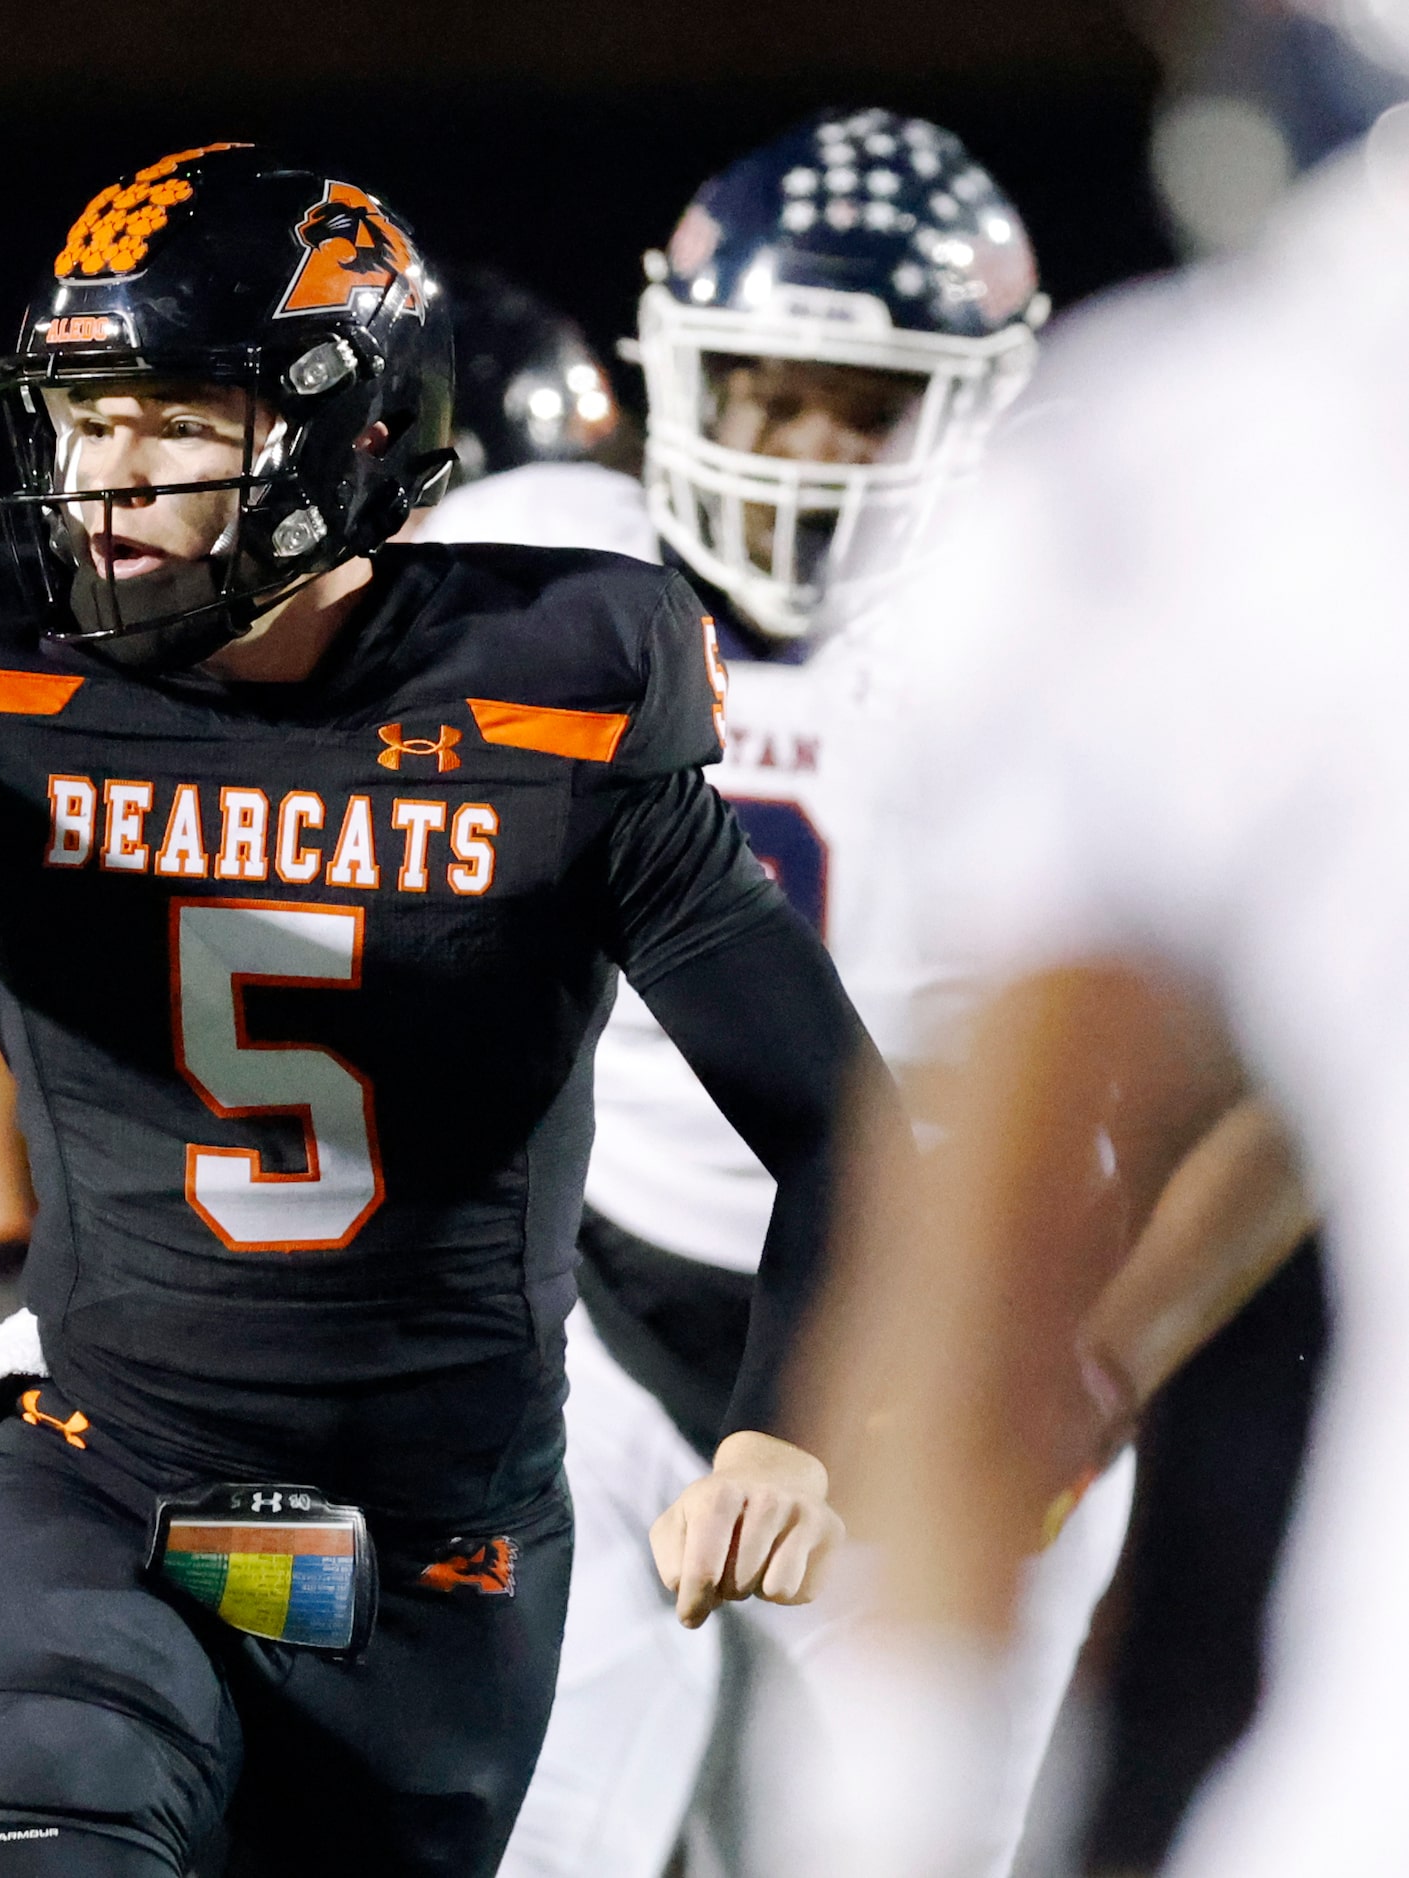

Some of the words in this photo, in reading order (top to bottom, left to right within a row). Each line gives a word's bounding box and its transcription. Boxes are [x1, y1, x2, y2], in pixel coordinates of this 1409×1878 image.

[728, 726, 824, 773] YAN
[43, 773, 500, 896] BEARCATS
[168, 896, 387, 1253] 5
